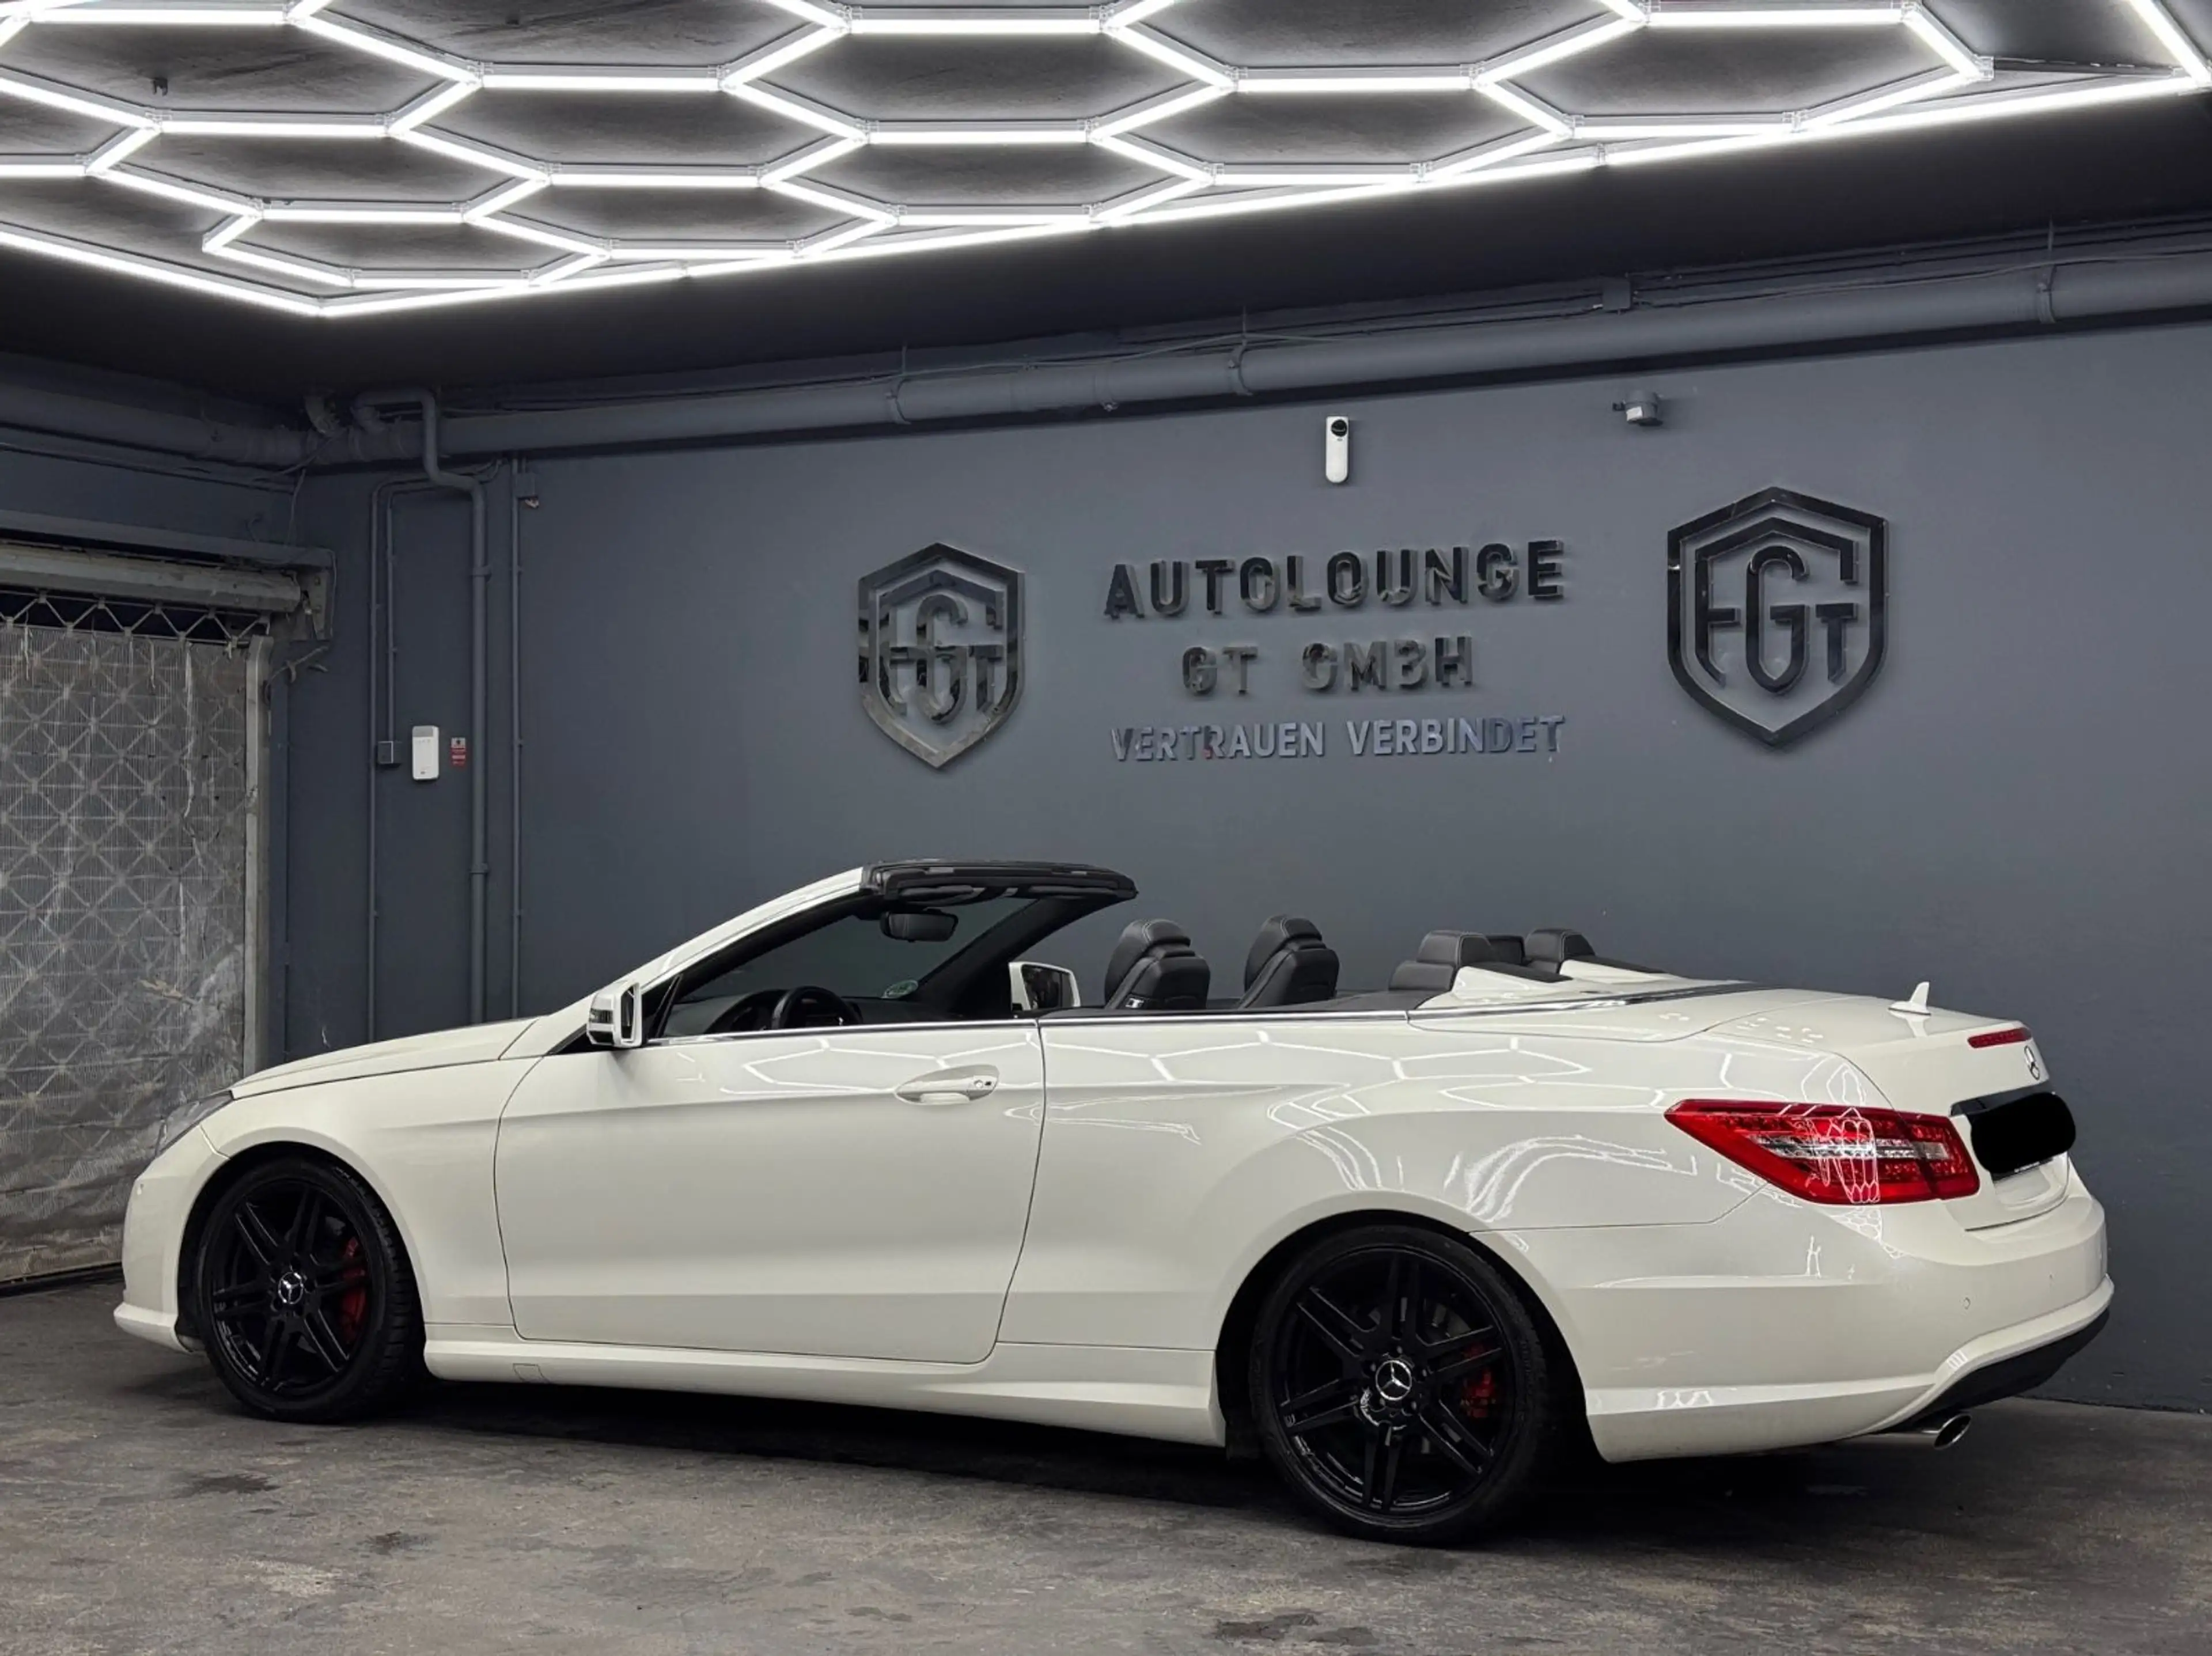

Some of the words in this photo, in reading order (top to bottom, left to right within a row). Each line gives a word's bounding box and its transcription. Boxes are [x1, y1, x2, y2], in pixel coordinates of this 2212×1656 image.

[1104, 540, 1565, 618] AUTOLOUNGE
[1182, 646, 1258, 695] GT
[1302, 636, 1472, 692] GMBH
[1110, 721, 1326, 761] VERTRAUEN
[1346, 715, 1566, 756] VERBINDET
